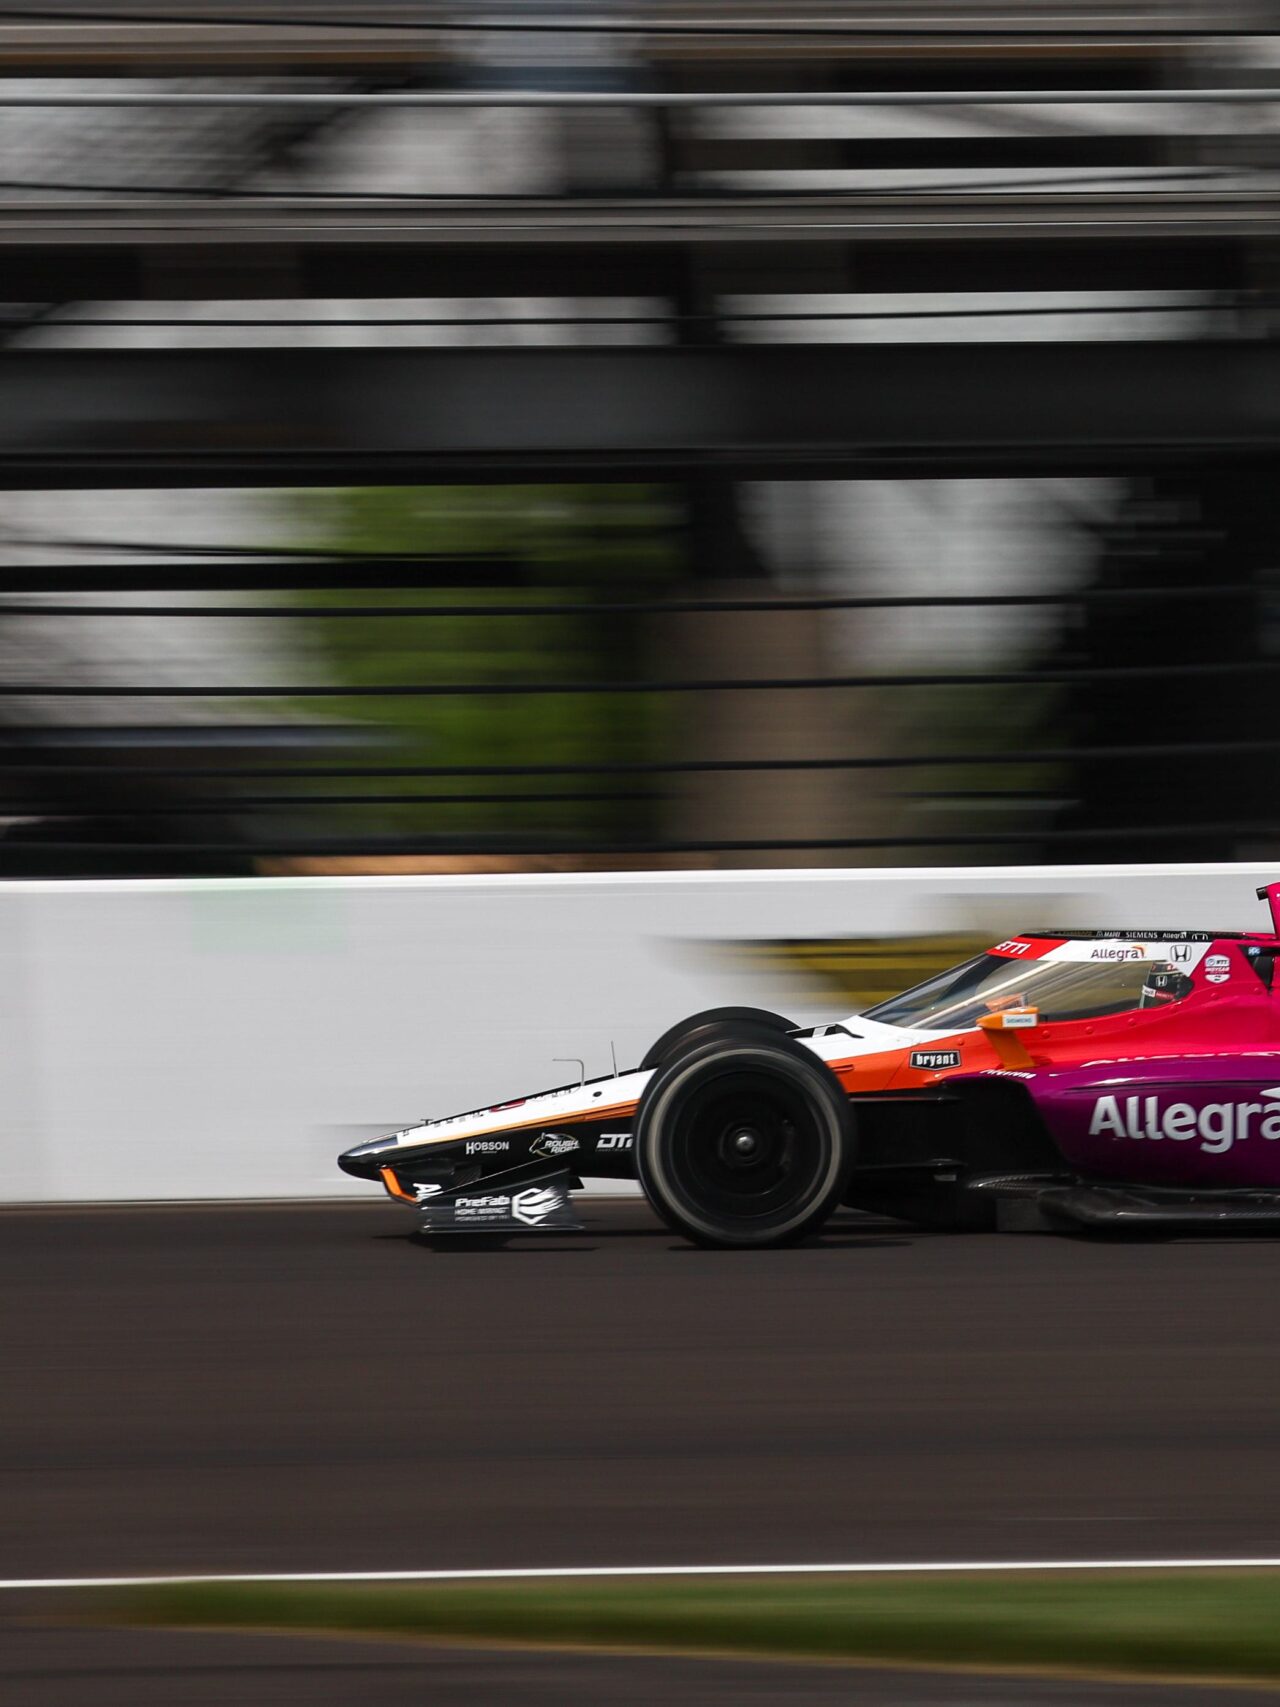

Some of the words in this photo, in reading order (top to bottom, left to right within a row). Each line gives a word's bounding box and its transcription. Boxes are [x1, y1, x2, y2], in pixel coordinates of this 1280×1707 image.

[1125, 931, 1158, 939] SIEMENS
[1162, 931, 1187, 940] Allegra
[1090, 947, 1139, 962] Allegra
[916, 1053, 955, 1067] bryant
[465, 1141, 510, 1155] HOBSON
[454, 1195, 511, 1208] PreFab
